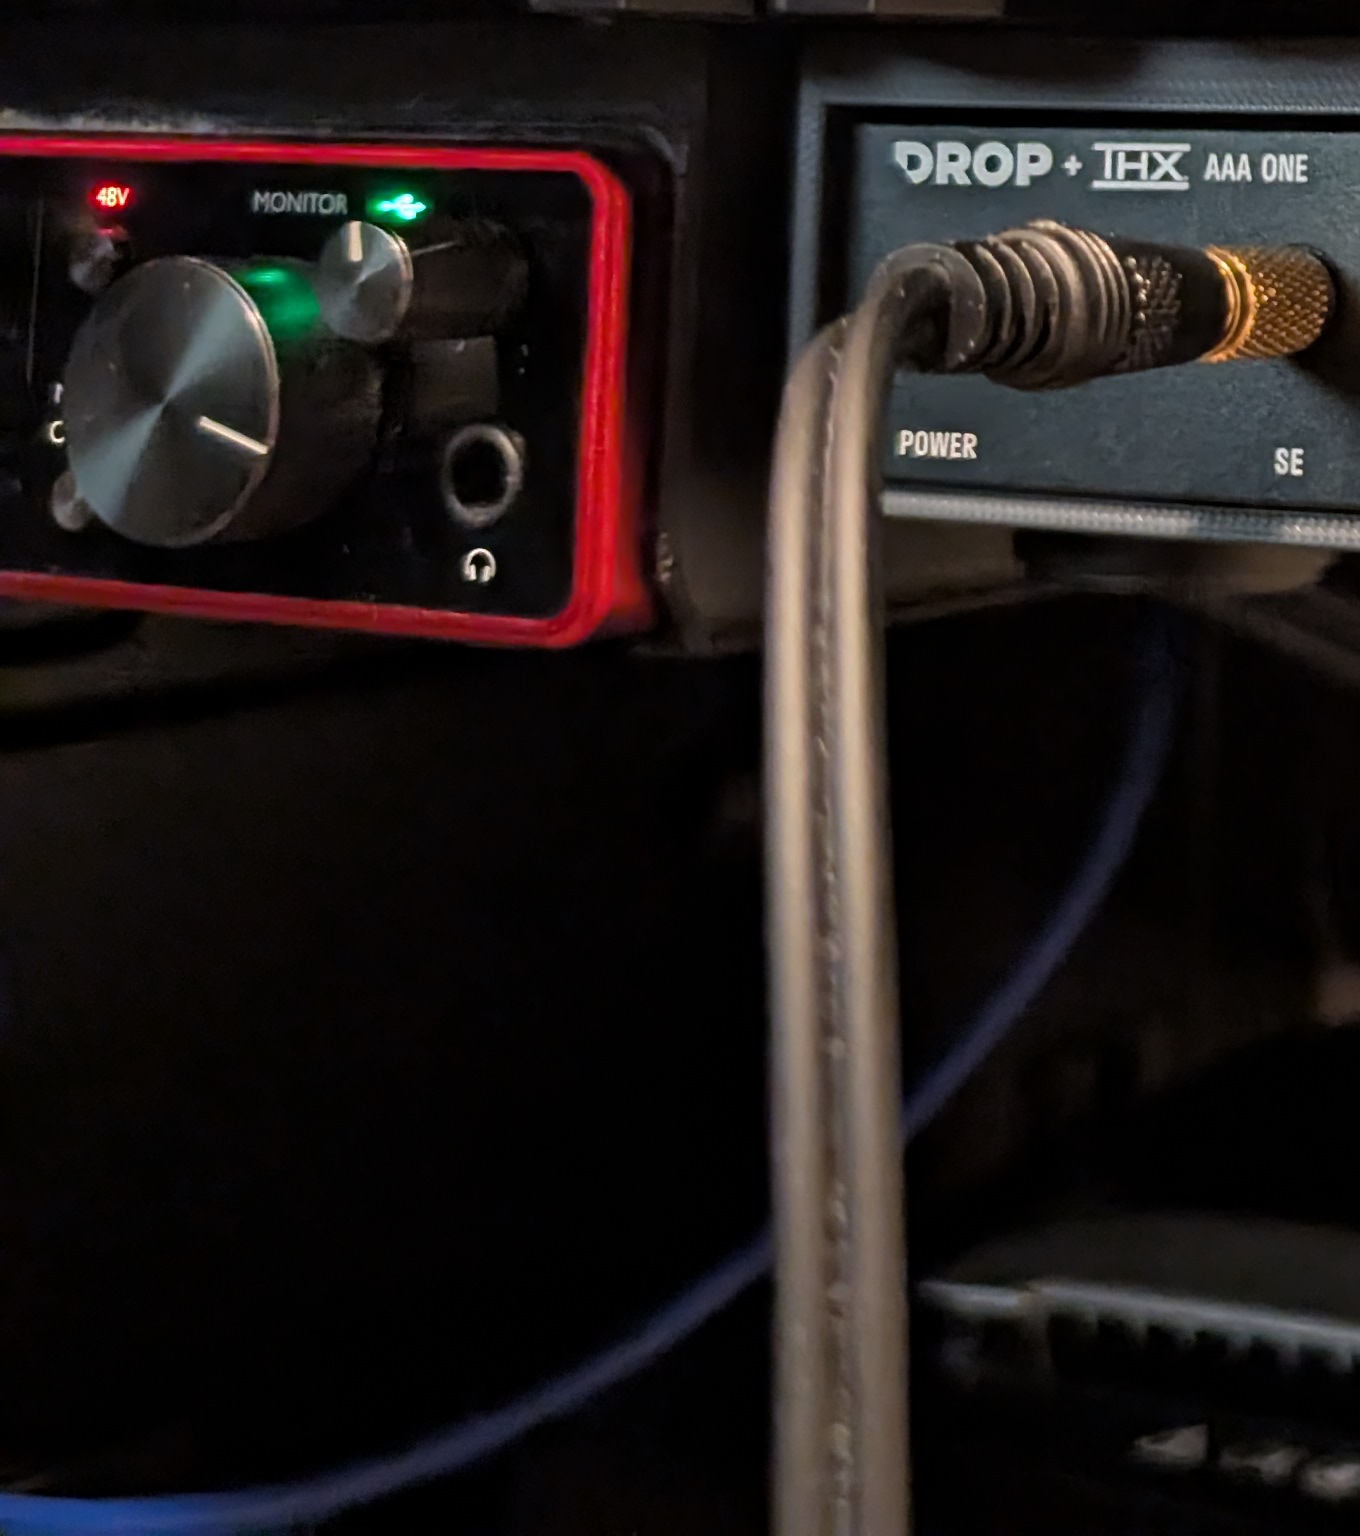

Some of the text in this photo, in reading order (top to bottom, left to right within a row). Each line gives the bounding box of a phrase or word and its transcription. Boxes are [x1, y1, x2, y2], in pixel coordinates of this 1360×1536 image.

[895, 141, 1054, 187] DROP
[1091, 141, 1192, 191] THX
[1204, 152, 1253, 183] AAA
[1261, 152, 1310, 184] ONE
[96, 185, 131, 208] 48V
[252, 190, 349, 217] MONITOR
[898, 429, 979, 460] POWER
[1274, 446, 1305, 478] SE
